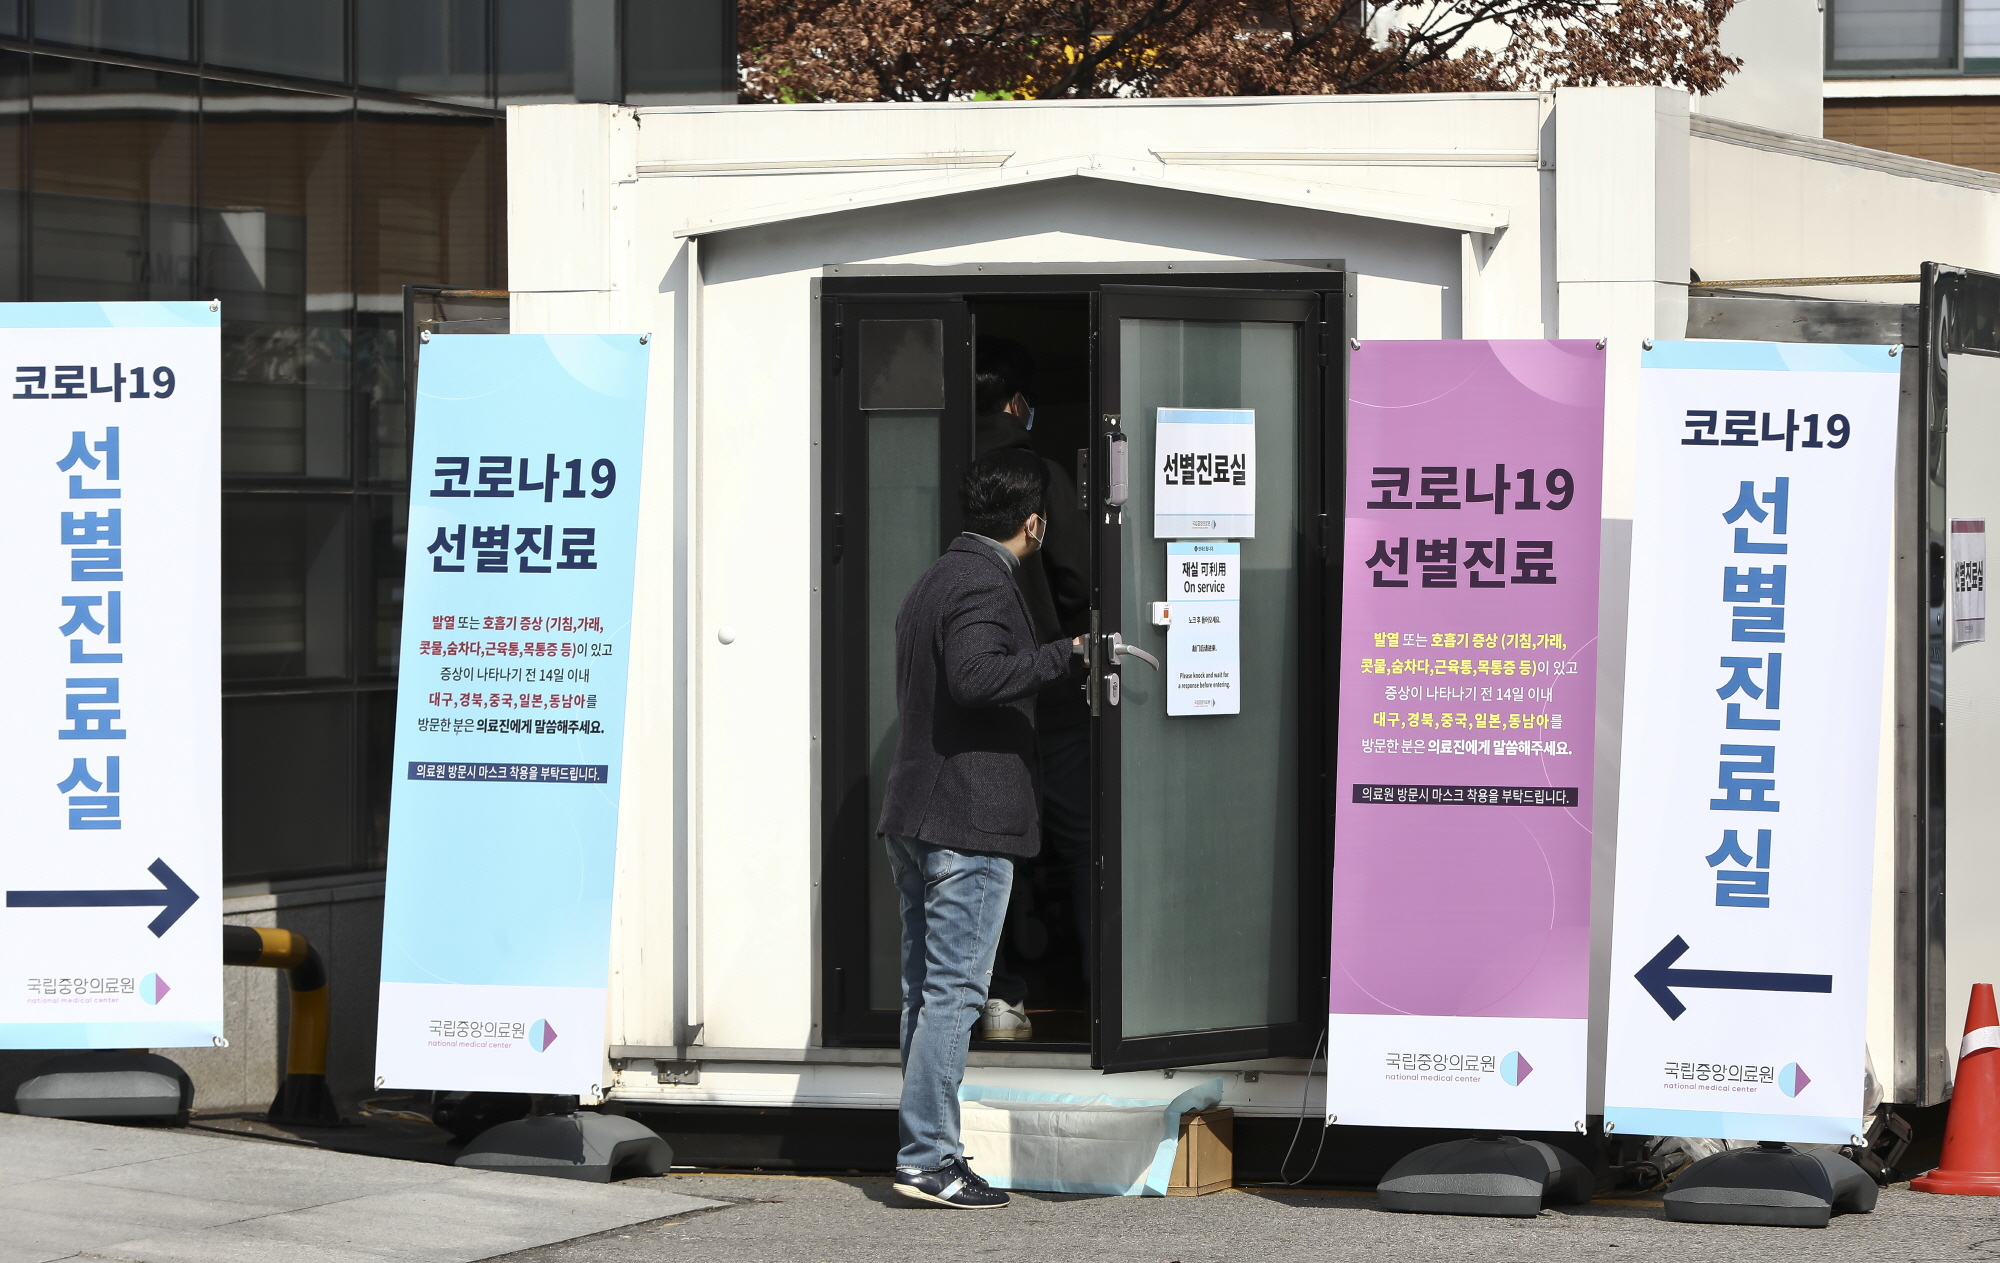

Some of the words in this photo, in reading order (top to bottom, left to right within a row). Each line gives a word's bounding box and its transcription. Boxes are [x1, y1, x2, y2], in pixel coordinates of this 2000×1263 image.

[12, 362, 175, 402] 코로나19
[1681, 408, 1851, 452] 코로나19
[430, 453, 616, 502] 코로나19
[1163, 453, 1246, 485] 선별진료실
[1367, 463, 1574, 514] 코로나19
[427, 524, 597, 573] 선별진료
[1182, 562, 1198, 577] 재실
[1201, 562, 1226, 576] 可利用
[1365, 537, 1556, 588] 선별진료
[1184, 581, 1195, 593] On
[1198, 580, 1225, 593] service
[56, 426, 126, 830] 선별진료실
[432, 615, 455, 630] 발열
[458, 616, 480, 630] 또는
[482, 615, 517, 631] 호흡기
[520, 616, 542, 631] 증상
[545, 616, 604, 633] (기침,가래,
[1373, 632, 1399, 648] 발열
[1402, 633, 1428, 647] 또는
[1430, 632, 1469, 648] 호흡기
[1472, 633, 1498, 648] 증상
[1501, 633, 1567, 650] (기침,가래,
[561, 642, 588, 659] 등)이
[591, 643, 613, 657] 있고
[440, 667, 474, 681] 증상이
[477, 667, 522, 682] 나타나기
[525, 668, 536, 682] 전
[540, 669, 564, 682] 14일
[567, 668, 589, 683] 이내
[1519, 660, 1549, 677] 등)이
[1553, 661, 1578, 675] 있고
[1384, 685, 1423, 701] 증상이
[1426, 686, 1477, 701] 나타나기
[1480, 687, 1492, 701] 전
[1496, 687, 1524, 701] 14일
[1527, 687, 1553, 702] 이내
[1705, 476, 1790, 909] 선별진료실
[418, 717, 451, 732] 방문한
[453, 718, 474, 733] 분은
[477, 718, 532, 734] 의료진에게
[535, 719, 604, 734] 말씀해주세요.
[1361, 738, 1399, 754] 방문한
[1401, 739, 1425, 754] 분은
[1428, 739, 1490, 755] 의료진에게
[1493, 740, 1572, 756] 말씀해주세요.
[416, 764, 445, 778] 의료원
[448, 765, 476, 779] 방문시
[479, 765, 507, 779] 마스크
[510, 766, 538, 780] 착용을
[541, 766, 600, 781] 부탁드립니다.
[1362, 787, 1394, 802] 의료원
[1397, 788, 1429, 803] 방문시
[1432, 788, 1464, 802] 마스크
[1467, 788, 1499, 804] 착용을
[1502, 789, 1570, 805] 부탁드립니다.
[27, 977, 135, 994] 국립중앙의료원
[429, 1020, 525, 1039] 국립중앙의료원
[1386, 1053, 1495, 1072] 국립중앙의료원
[1420, 1074, 1452, 1082] medical
[1455, 1075, 1481, 1083] center
[1664, 1062, 1774, 1084] 국립중앙의료원
[1664, 1082, 1696, 1090] national
[1698, 1084, 1729, 1092] medical
[1732, 1085, 1757, 1093] center
